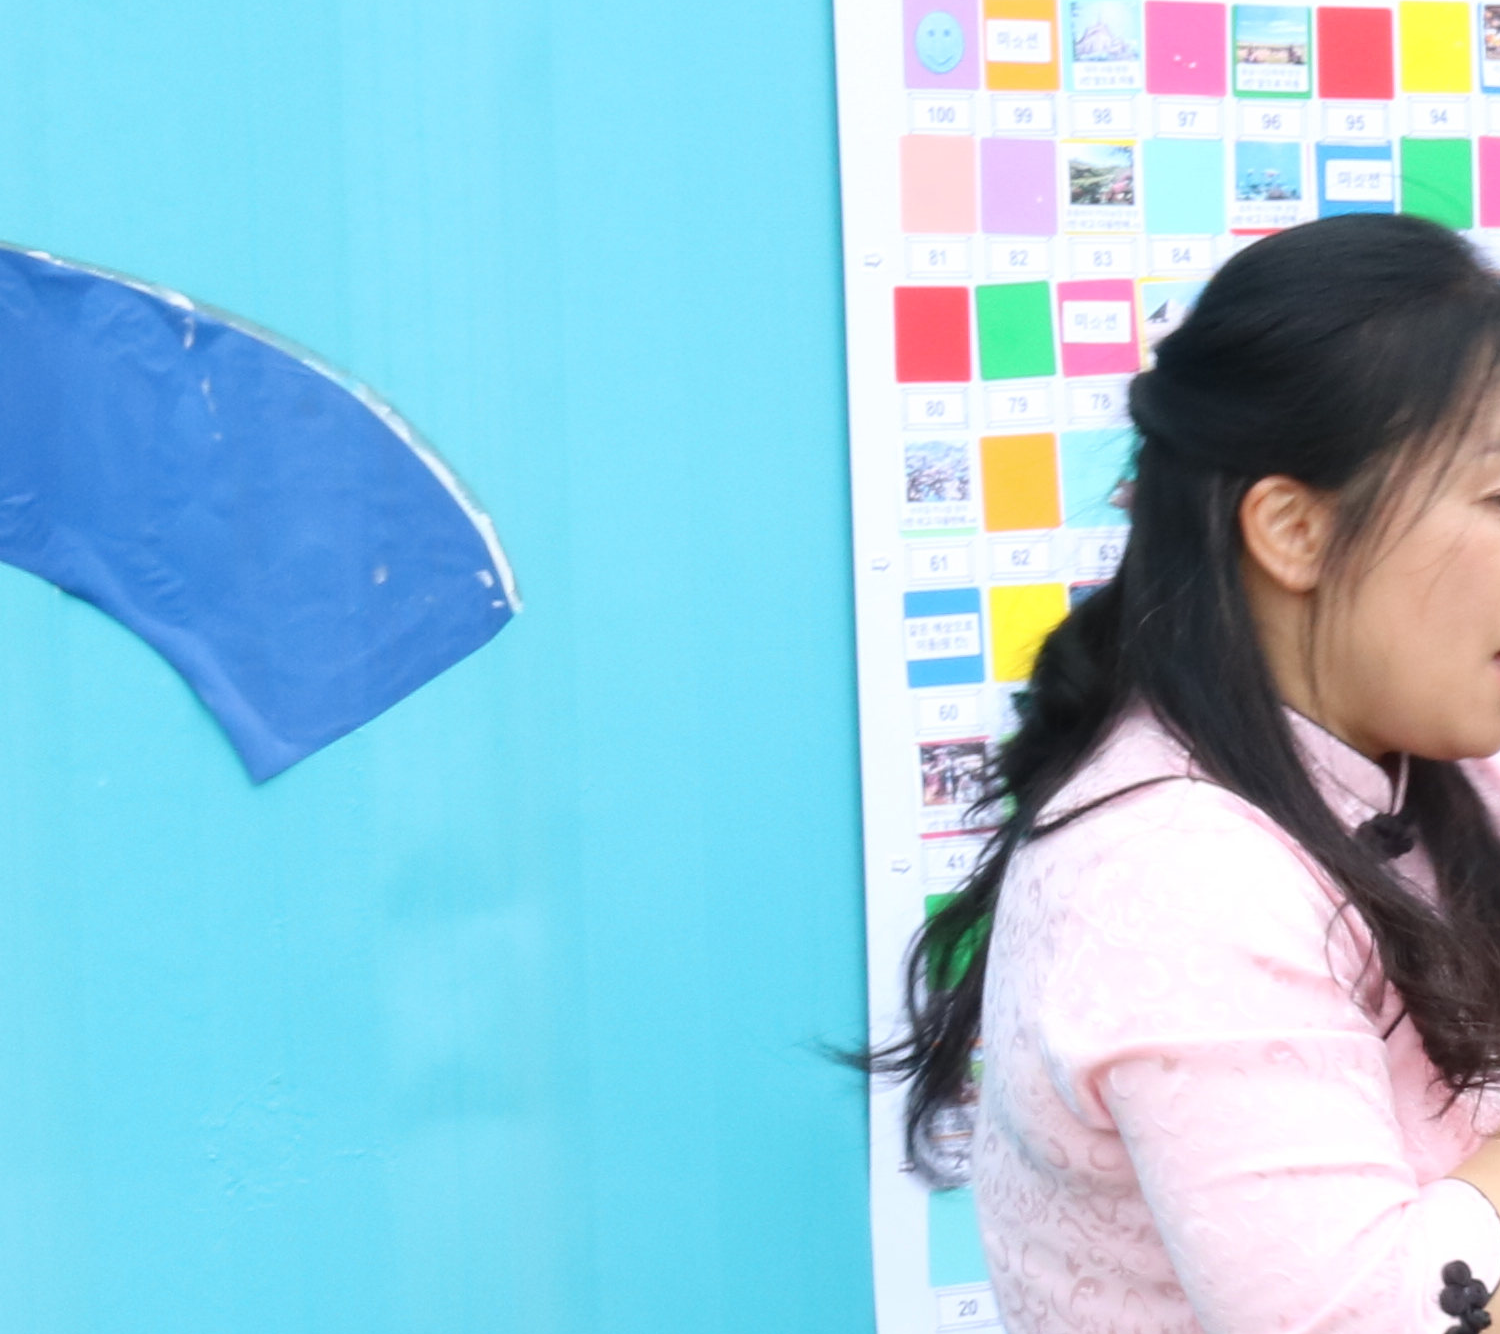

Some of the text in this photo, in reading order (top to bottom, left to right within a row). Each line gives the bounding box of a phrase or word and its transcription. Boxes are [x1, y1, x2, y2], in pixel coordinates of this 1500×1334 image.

[926, 105, 957, 124] 100
[1013, 105, 1034, 125] 99
[1091, 106, 1113, 125] 98
[1176, 110, 1199, 128] 97
[1260, 113, 1283, 131] 96
[1344, 113, 1367, 131] 95
[1428, 108, 1450, 126] 94
[927, 248, 948, 266] 81
[1008, 248, 1029, 267] 82
[1092, 249, 1114, 267] 83
[1170, 246, 1192, 265] 84
[1008, 395, 1028, 414] 79
[1089, 393, 1111, 411] 78
[929, 552, 949, 572] 61
[1010, 548, 1032, 567] 62
[938, 703, 959, 722] 60
[957, 1299, 978, 1317] 20
